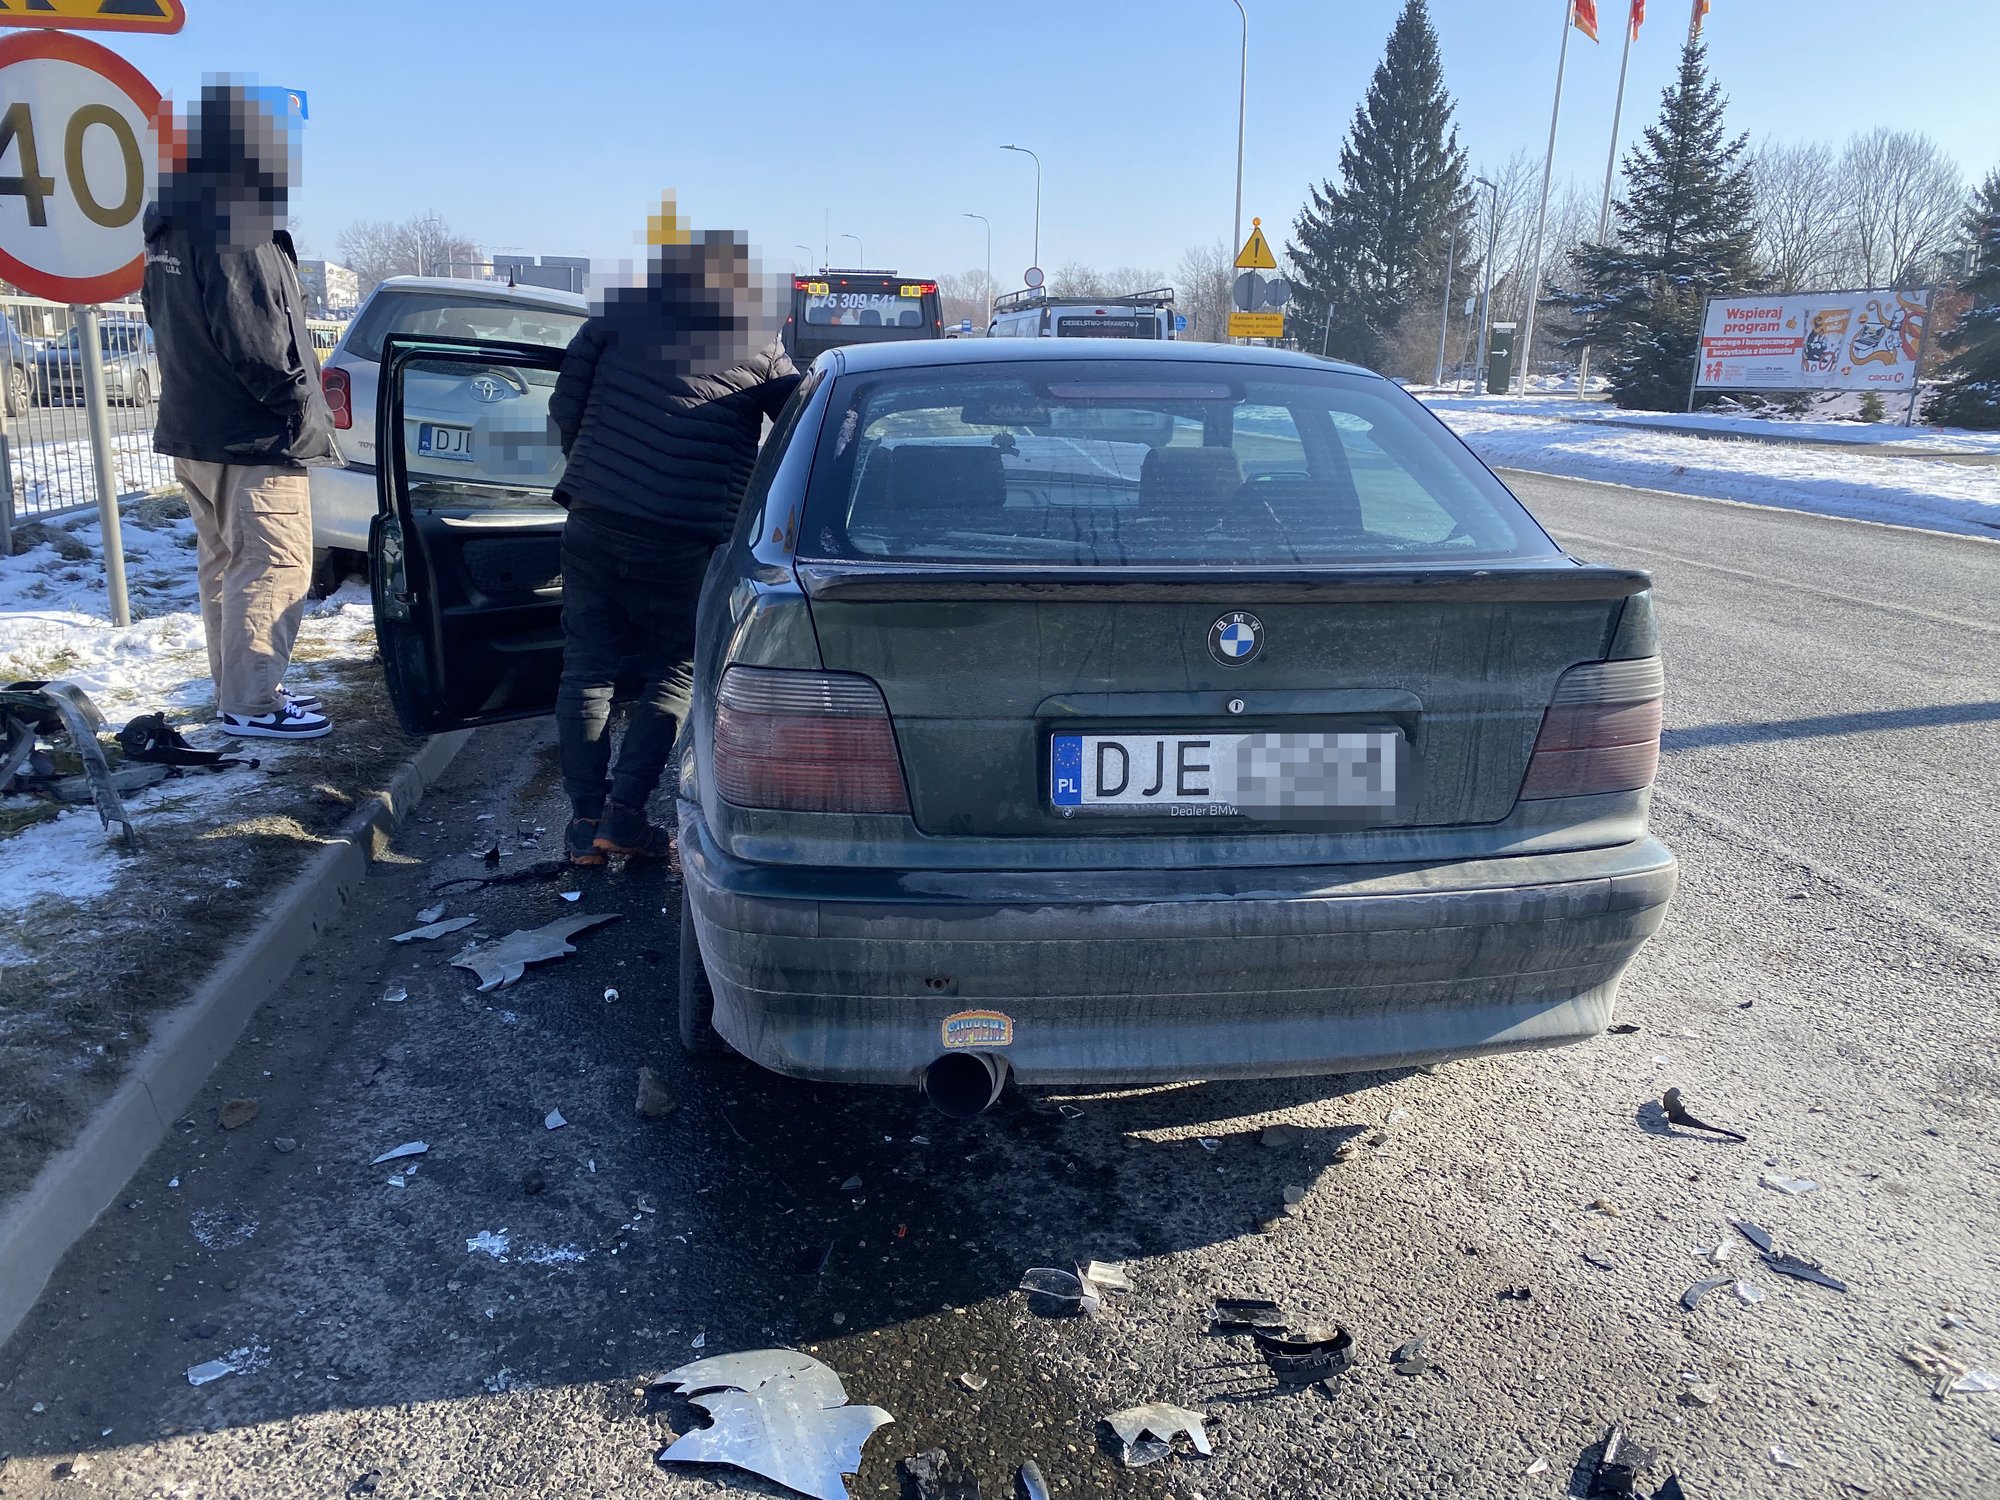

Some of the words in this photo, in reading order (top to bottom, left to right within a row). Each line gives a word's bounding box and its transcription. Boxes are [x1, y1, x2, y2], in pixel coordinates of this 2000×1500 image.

[0, 102, 144, 228] 40
[811, 292, 837, 308] 575
[840, 293, 867, 309] 309
[870, 294, 896, 309] 541
[1727, 306, 1783, 321] Wspieraj
[1723, 322, 1780, 335] program
[1710, 339, 1741, 347] mądrego
[1746, 338, 1795, 347] bezpiecznego
[1712, 349, 1753, 358] korzystania
[1759, 347, 1793, 355] internetu
[1895, 373, 1904, 383] K
[421, 440, 431, 448] PL
[1216, 613, 1261, 632] BMW
[1096, 741, 1211, 797] DJE
[1058, 778, 1078, 793] PL
[1171, 806, 1207, 817] Dealer
[1209, 805, 1238, 816] BMW
